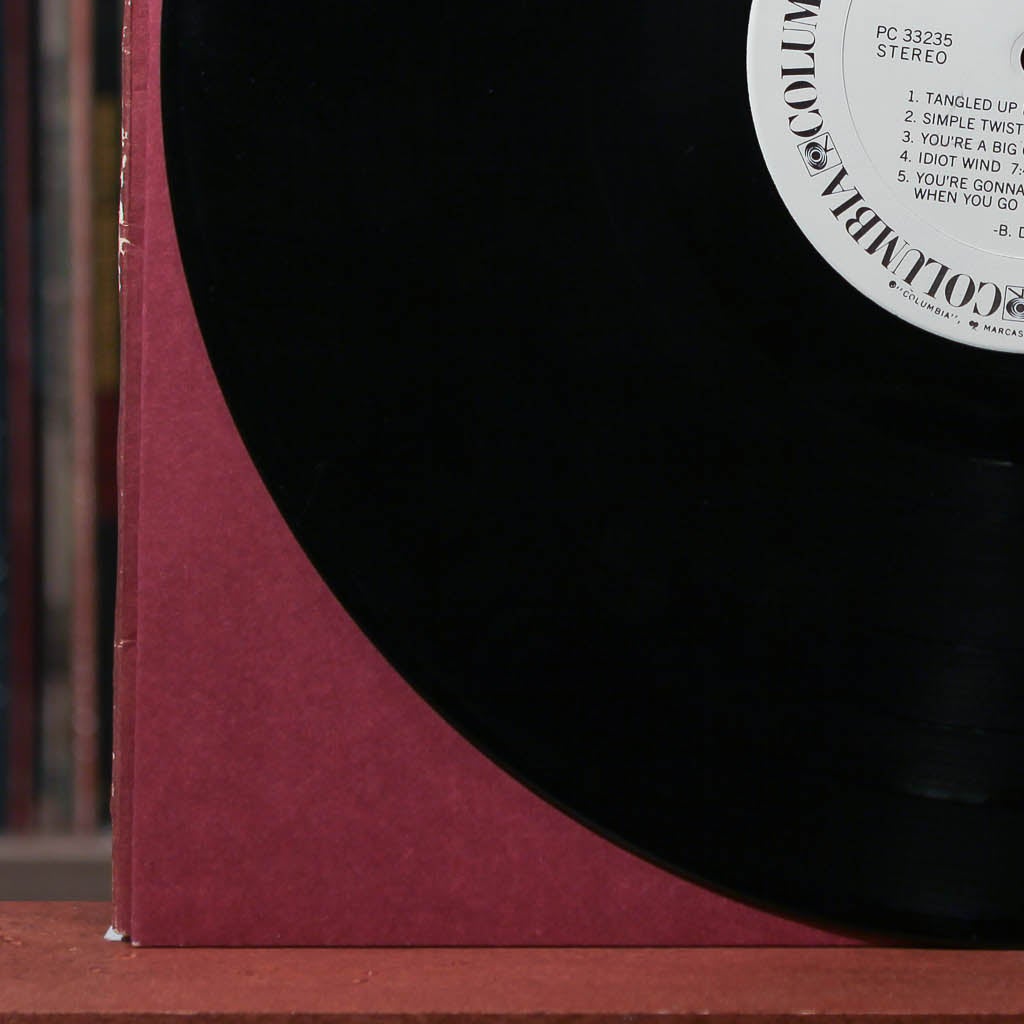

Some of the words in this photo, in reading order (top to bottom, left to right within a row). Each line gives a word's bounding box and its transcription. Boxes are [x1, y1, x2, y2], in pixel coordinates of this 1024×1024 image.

[876, 25, 897, 41] PC
[903, 29, 953, 47] 33235
[876, 44, 948, 64] STEREO
[908, 90, 919, 103] 1.
[926, 92, 993, 111] TANGLED
[997, 101, 1018, 114] UP
[904, 110, 916, 124] 2.
[922, 112, 976, 130] SIMPLE
[981, 119, 1024, 135] TWIST
[902, 131, 914, 144] 3.
[921, 132, 973, 150] YOU'RE
[977, 140, 987, 152] A
[992, 141, 1017, 156] BIG
[899, 150, 912, 163] 4.
[918, 152, 957, 167] IDIOT
[962, 157, 1001, 173] WIND
[897, 170, 909, 183] 5.
[916, 171, 968, 189] YOU'RE
[973, 179, 1024, 196] GONNA
[914, 187, 957, 203] WHEN
[963, 193, 992, 207] YOU
[997, 197, 1018, 211] GO
[821, 166, 1001, 317] COLUMBIA
[983, 324, 1024, 338] MARCAS
